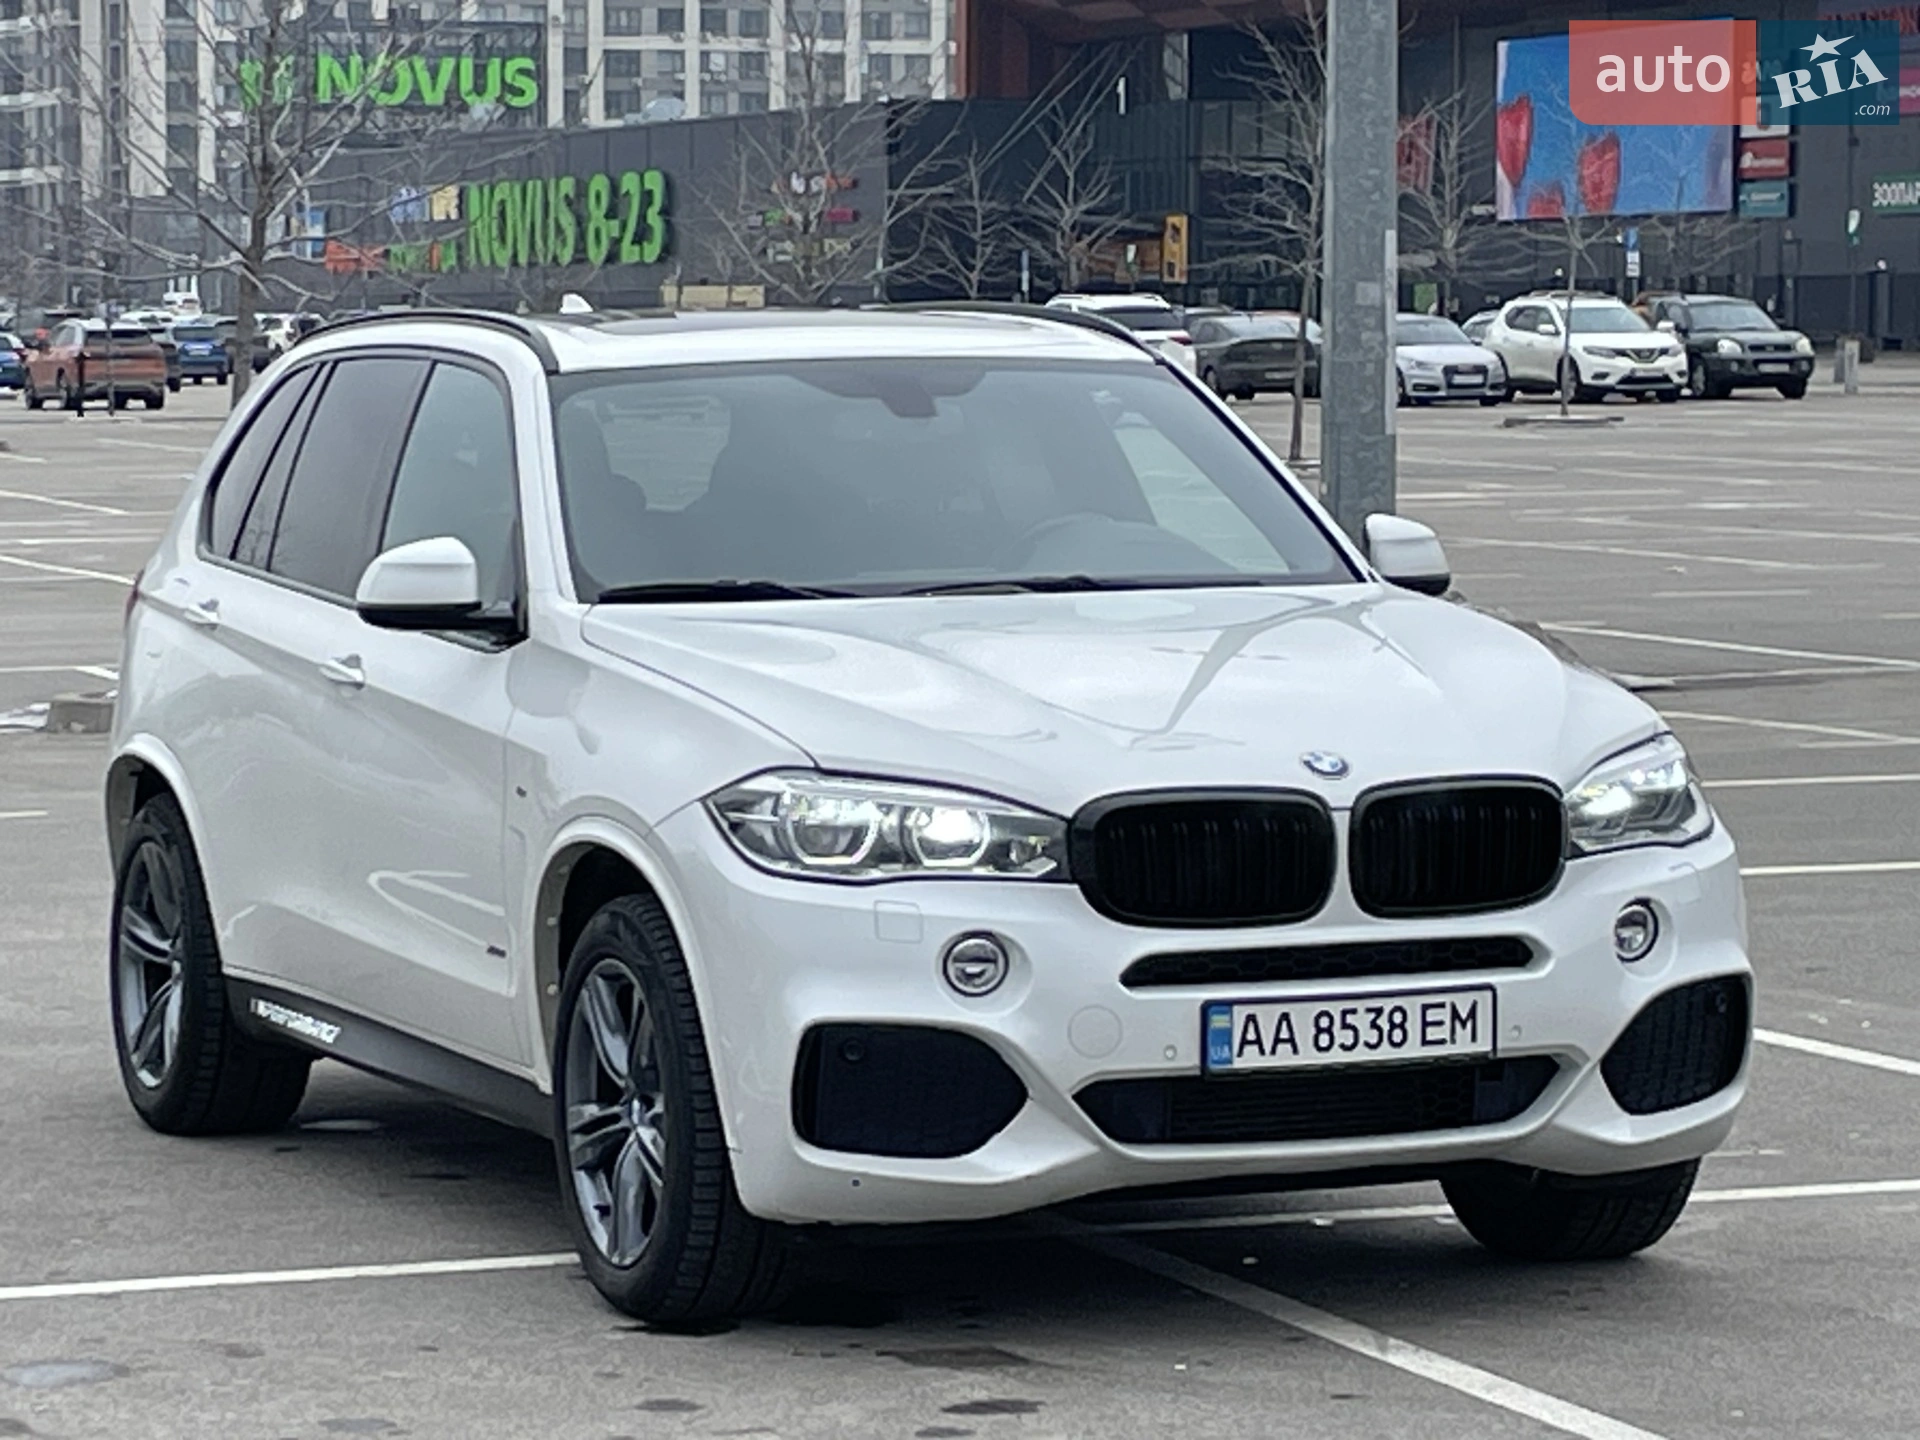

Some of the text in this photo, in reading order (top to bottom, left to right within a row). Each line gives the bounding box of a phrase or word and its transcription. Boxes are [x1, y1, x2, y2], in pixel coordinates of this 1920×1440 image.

[315, 53, 539, 108] NOVUS
[468, 175, 576, 268] NOVUS
[587, 169, 664, 265] 8-23
[1236, 999, 1478, 1058] AA 8538 EM
